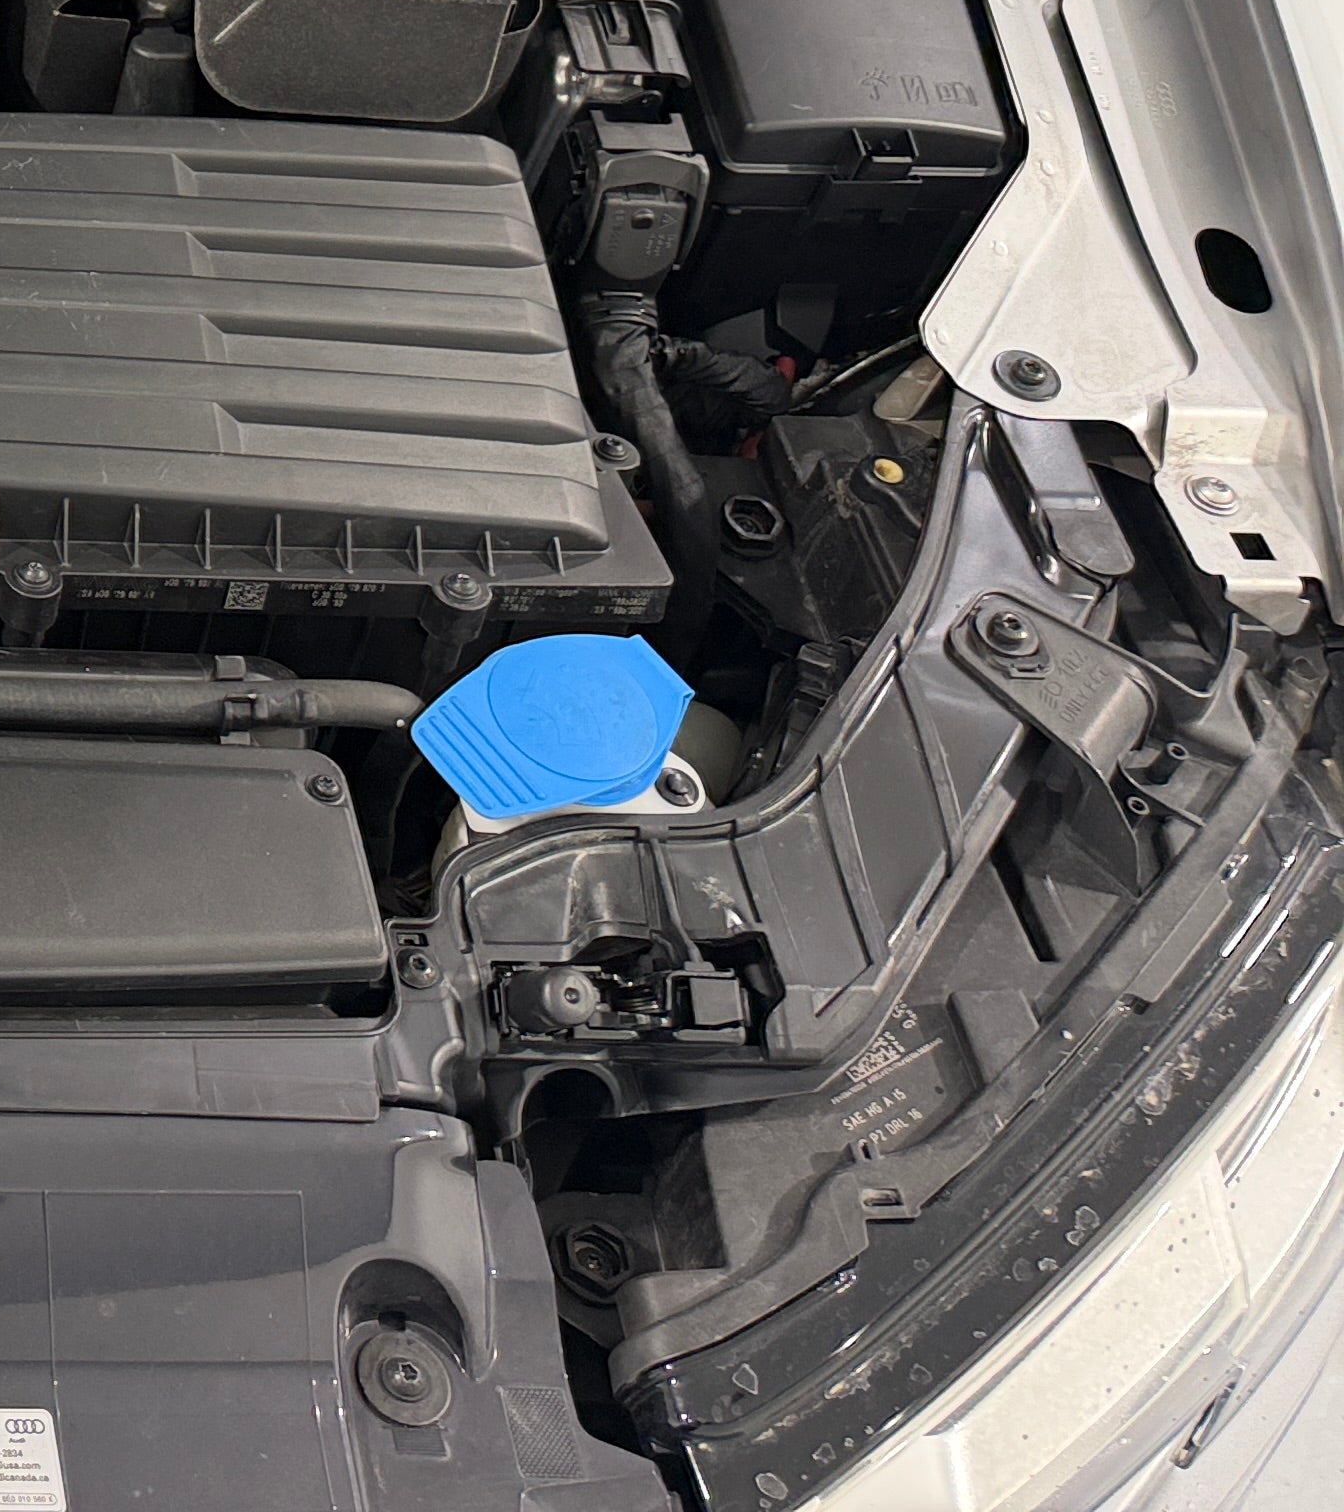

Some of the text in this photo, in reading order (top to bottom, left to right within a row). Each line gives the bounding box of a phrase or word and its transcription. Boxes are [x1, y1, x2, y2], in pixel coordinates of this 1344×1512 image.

[842, 1088, 907, 1131] SAE HG A 15
[884, 1118, 910, 1136] DRL
[907, 1108, 923, 1120] 16
